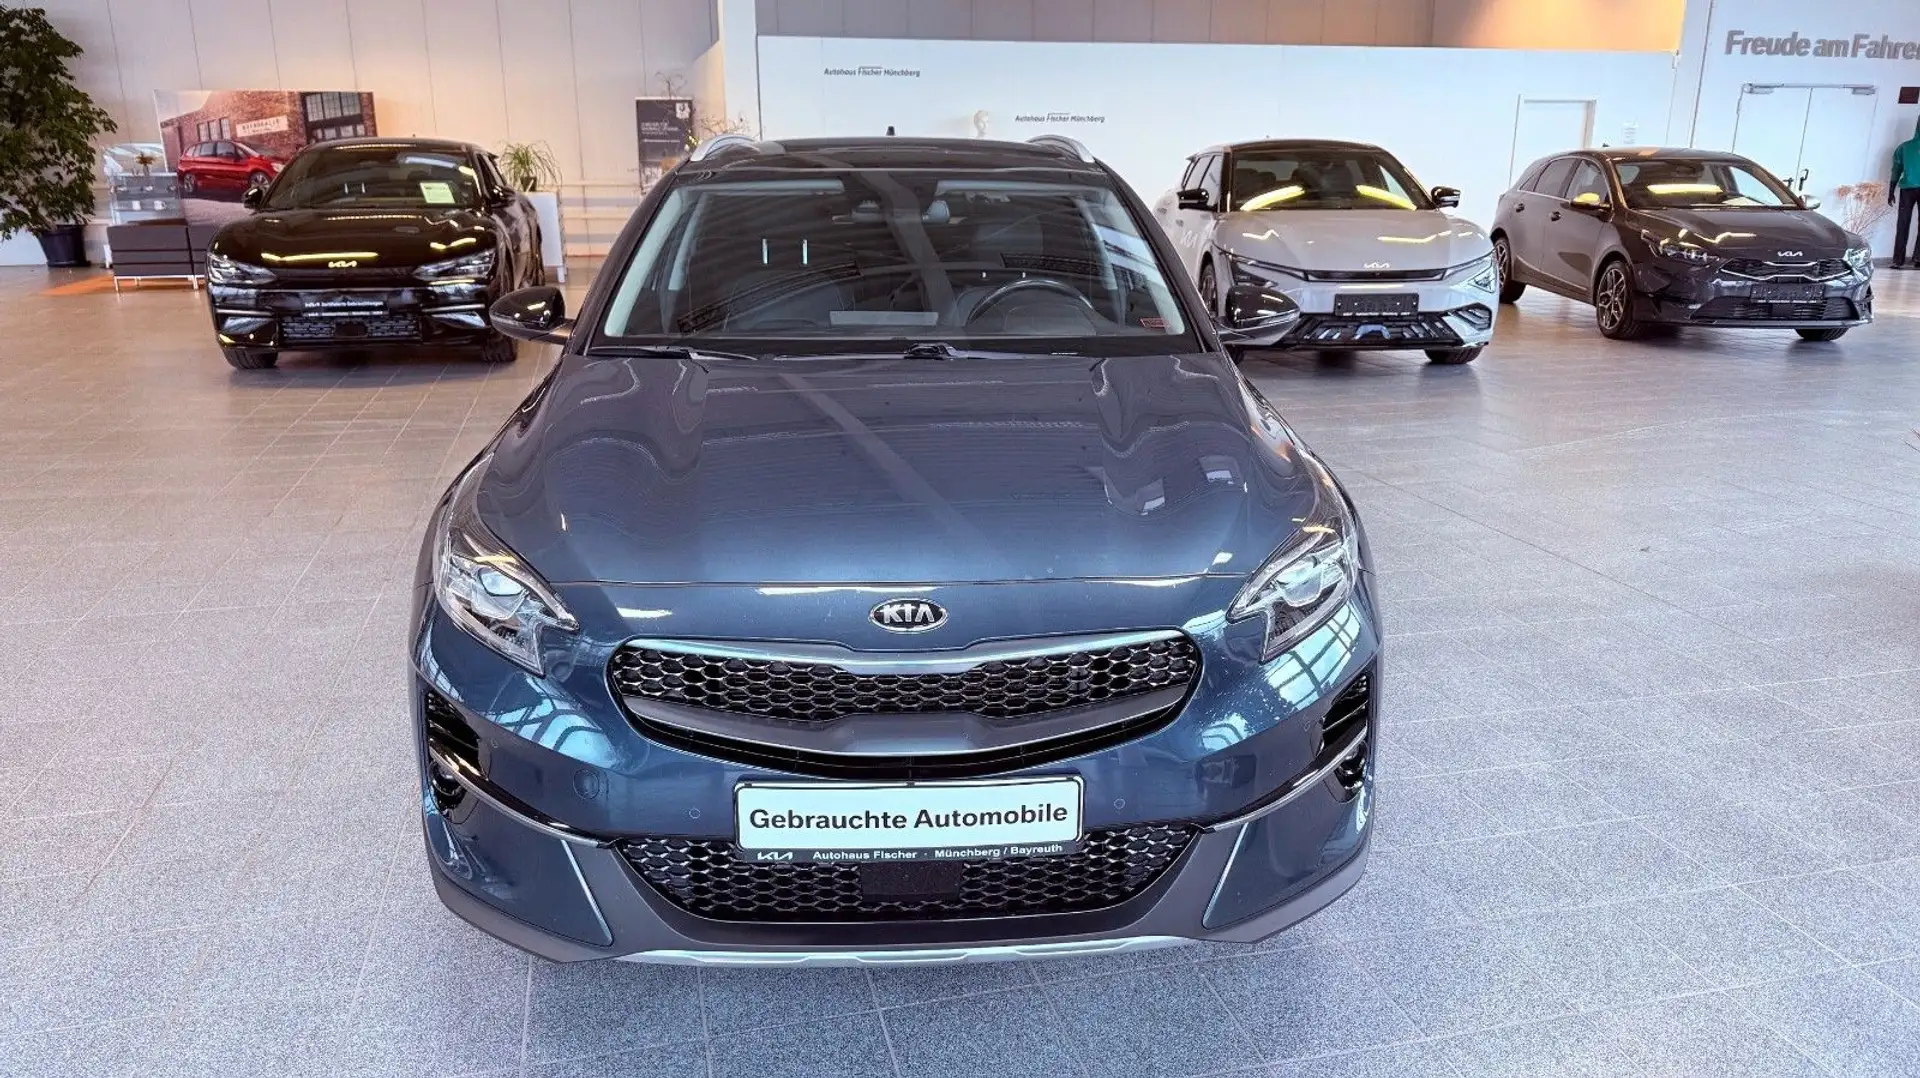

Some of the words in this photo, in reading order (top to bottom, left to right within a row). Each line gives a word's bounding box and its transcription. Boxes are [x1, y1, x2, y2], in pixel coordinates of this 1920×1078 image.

[1724, 30, 1811, 56] Freude
[1813, 37, 1849, 57] am
[1851, 33, 1920, 60] Fahre
[823, 68, 857, 76] Autohaus
[858, 66, 883, 76] Fischer
[1046, 112, 1070, 122] Fischer
[877, 603, 935, 624] KIA
[749, 808, 908, 830] Gebrauchte
[914, 803, 1068, 829] Automobile
[812, 850, 870, 860] Autohaus
[873, 849, 918, 860] Fischer
[934, 847, 1001, 859] Münchberg
[1010, 843, 1064, 857] Bayreuth
